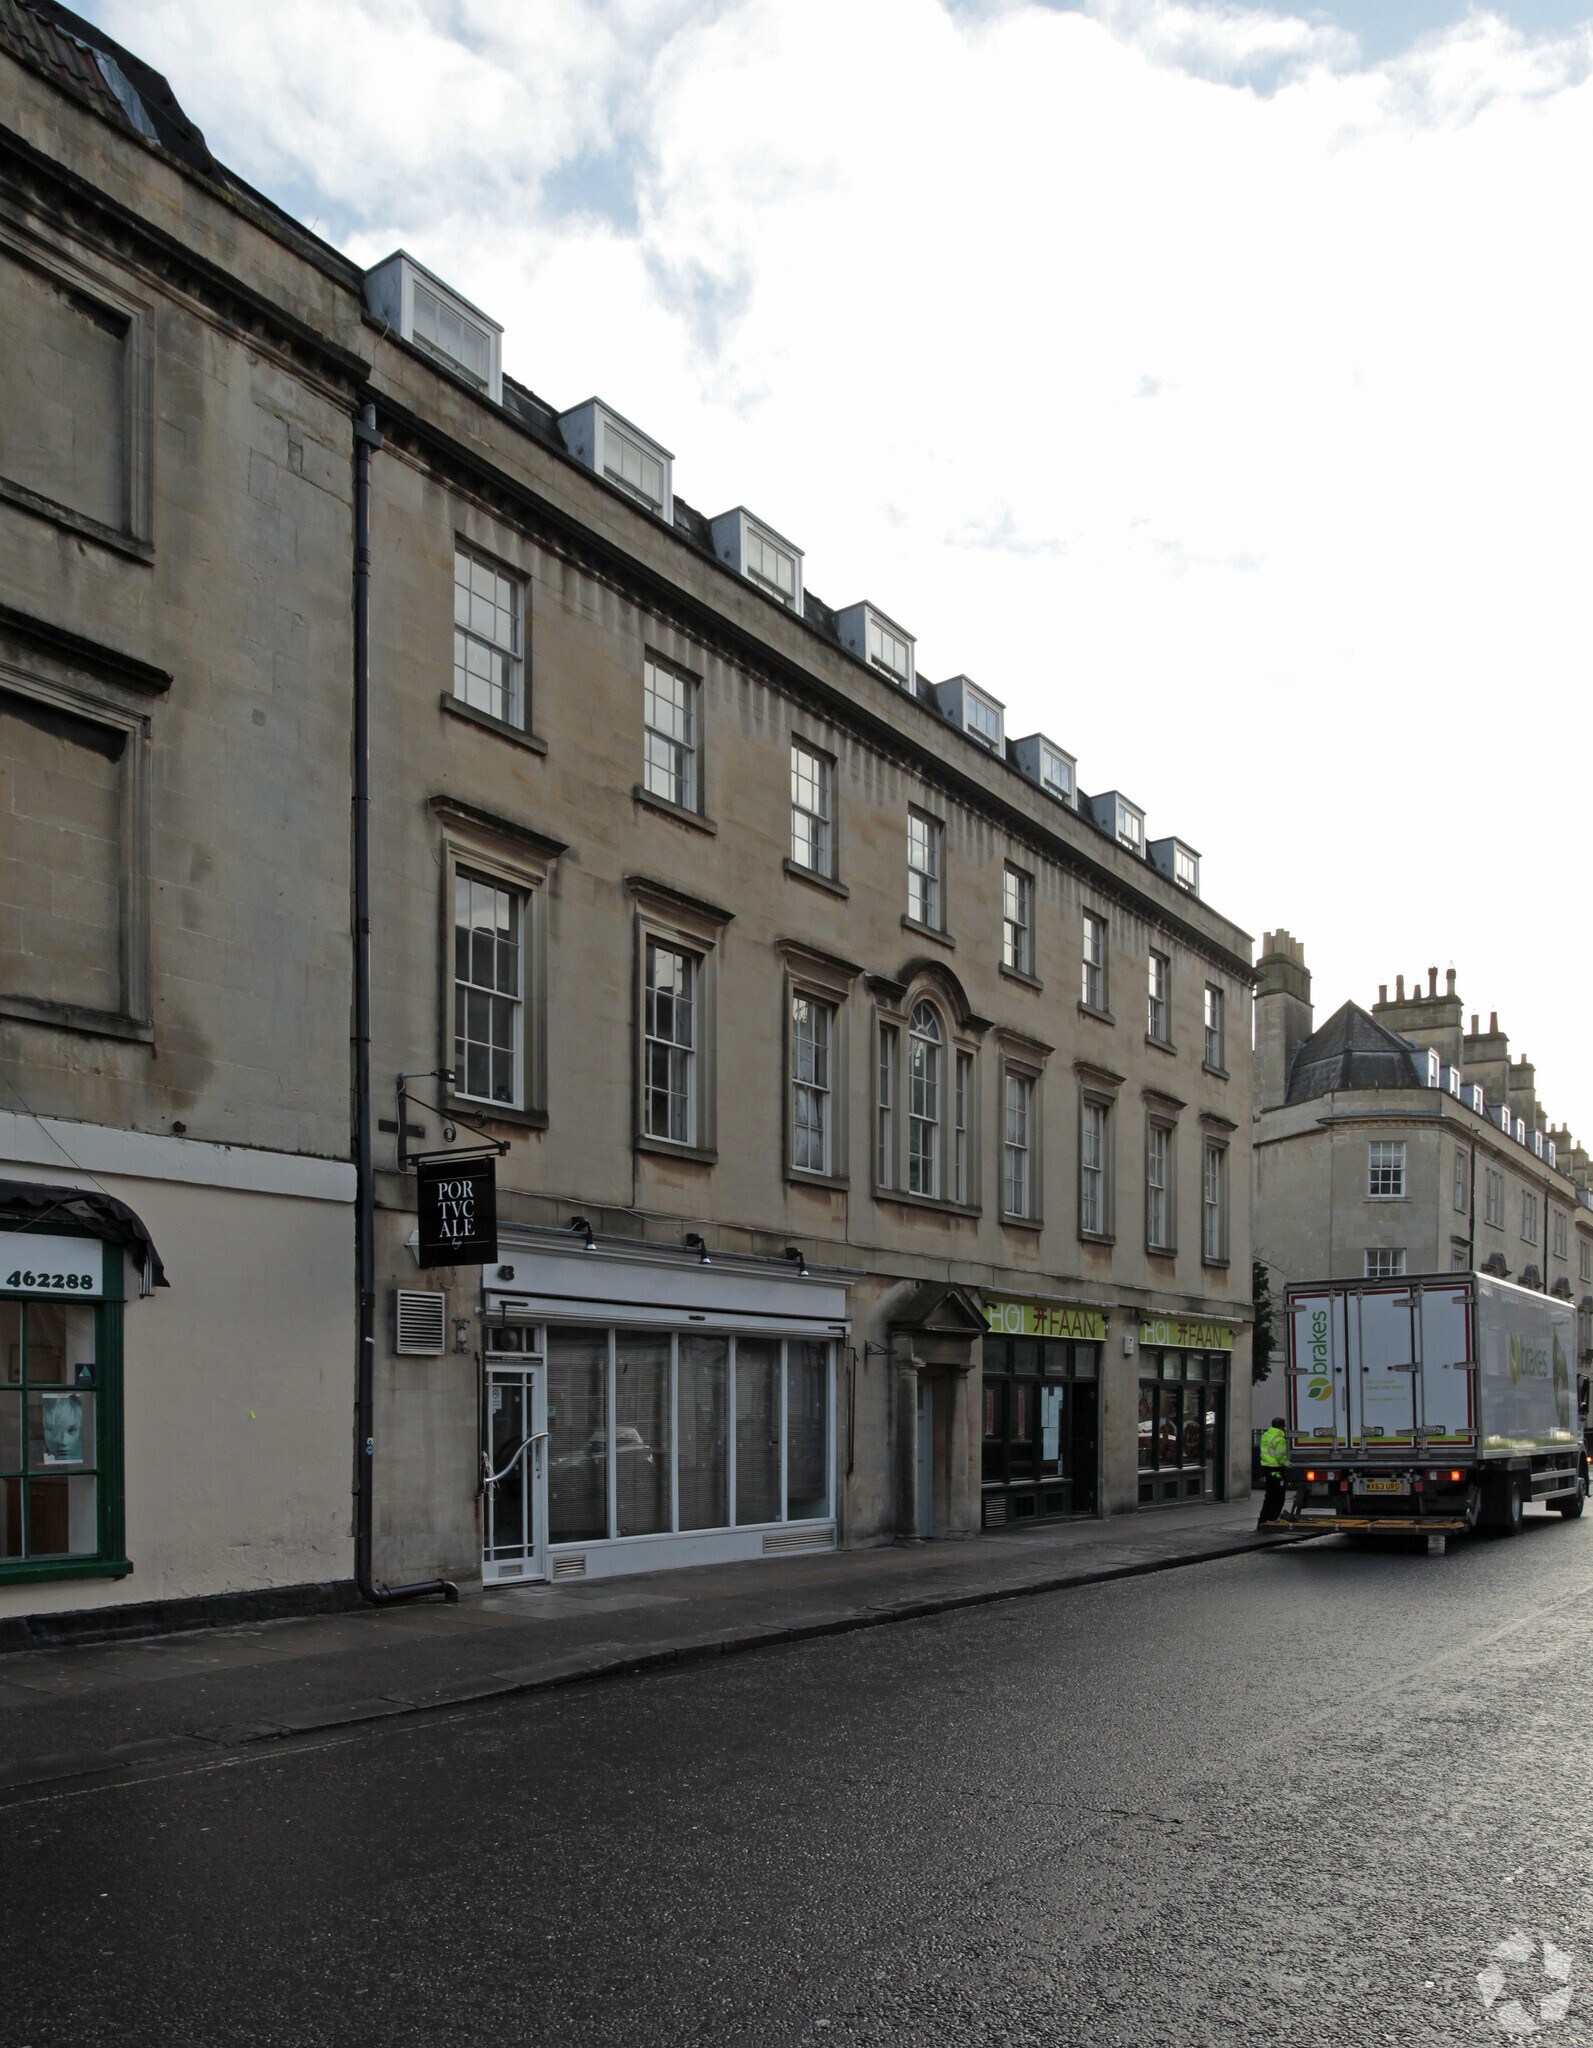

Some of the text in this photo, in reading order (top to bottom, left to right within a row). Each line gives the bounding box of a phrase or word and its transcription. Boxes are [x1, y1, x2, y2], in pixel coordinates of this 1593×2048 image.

[437, 1180, 474, 1200] POR
[437, 1199, 475, 1219] TVC
[439, 1218, 475, 1238] ALE
[6, 1270, 93, 1290] 462288
[989, 1302, 1024, 1333] HOI
[1050, 1307, 1096, 1338] FAAN
[1144, 1320, 1170, 1345] HOI
[1189, 1325, 1222, 1349] FAAN
[1307, 1310, 1328, 1376] brakes
[1520, 1335, 1548, 1377] brakes
